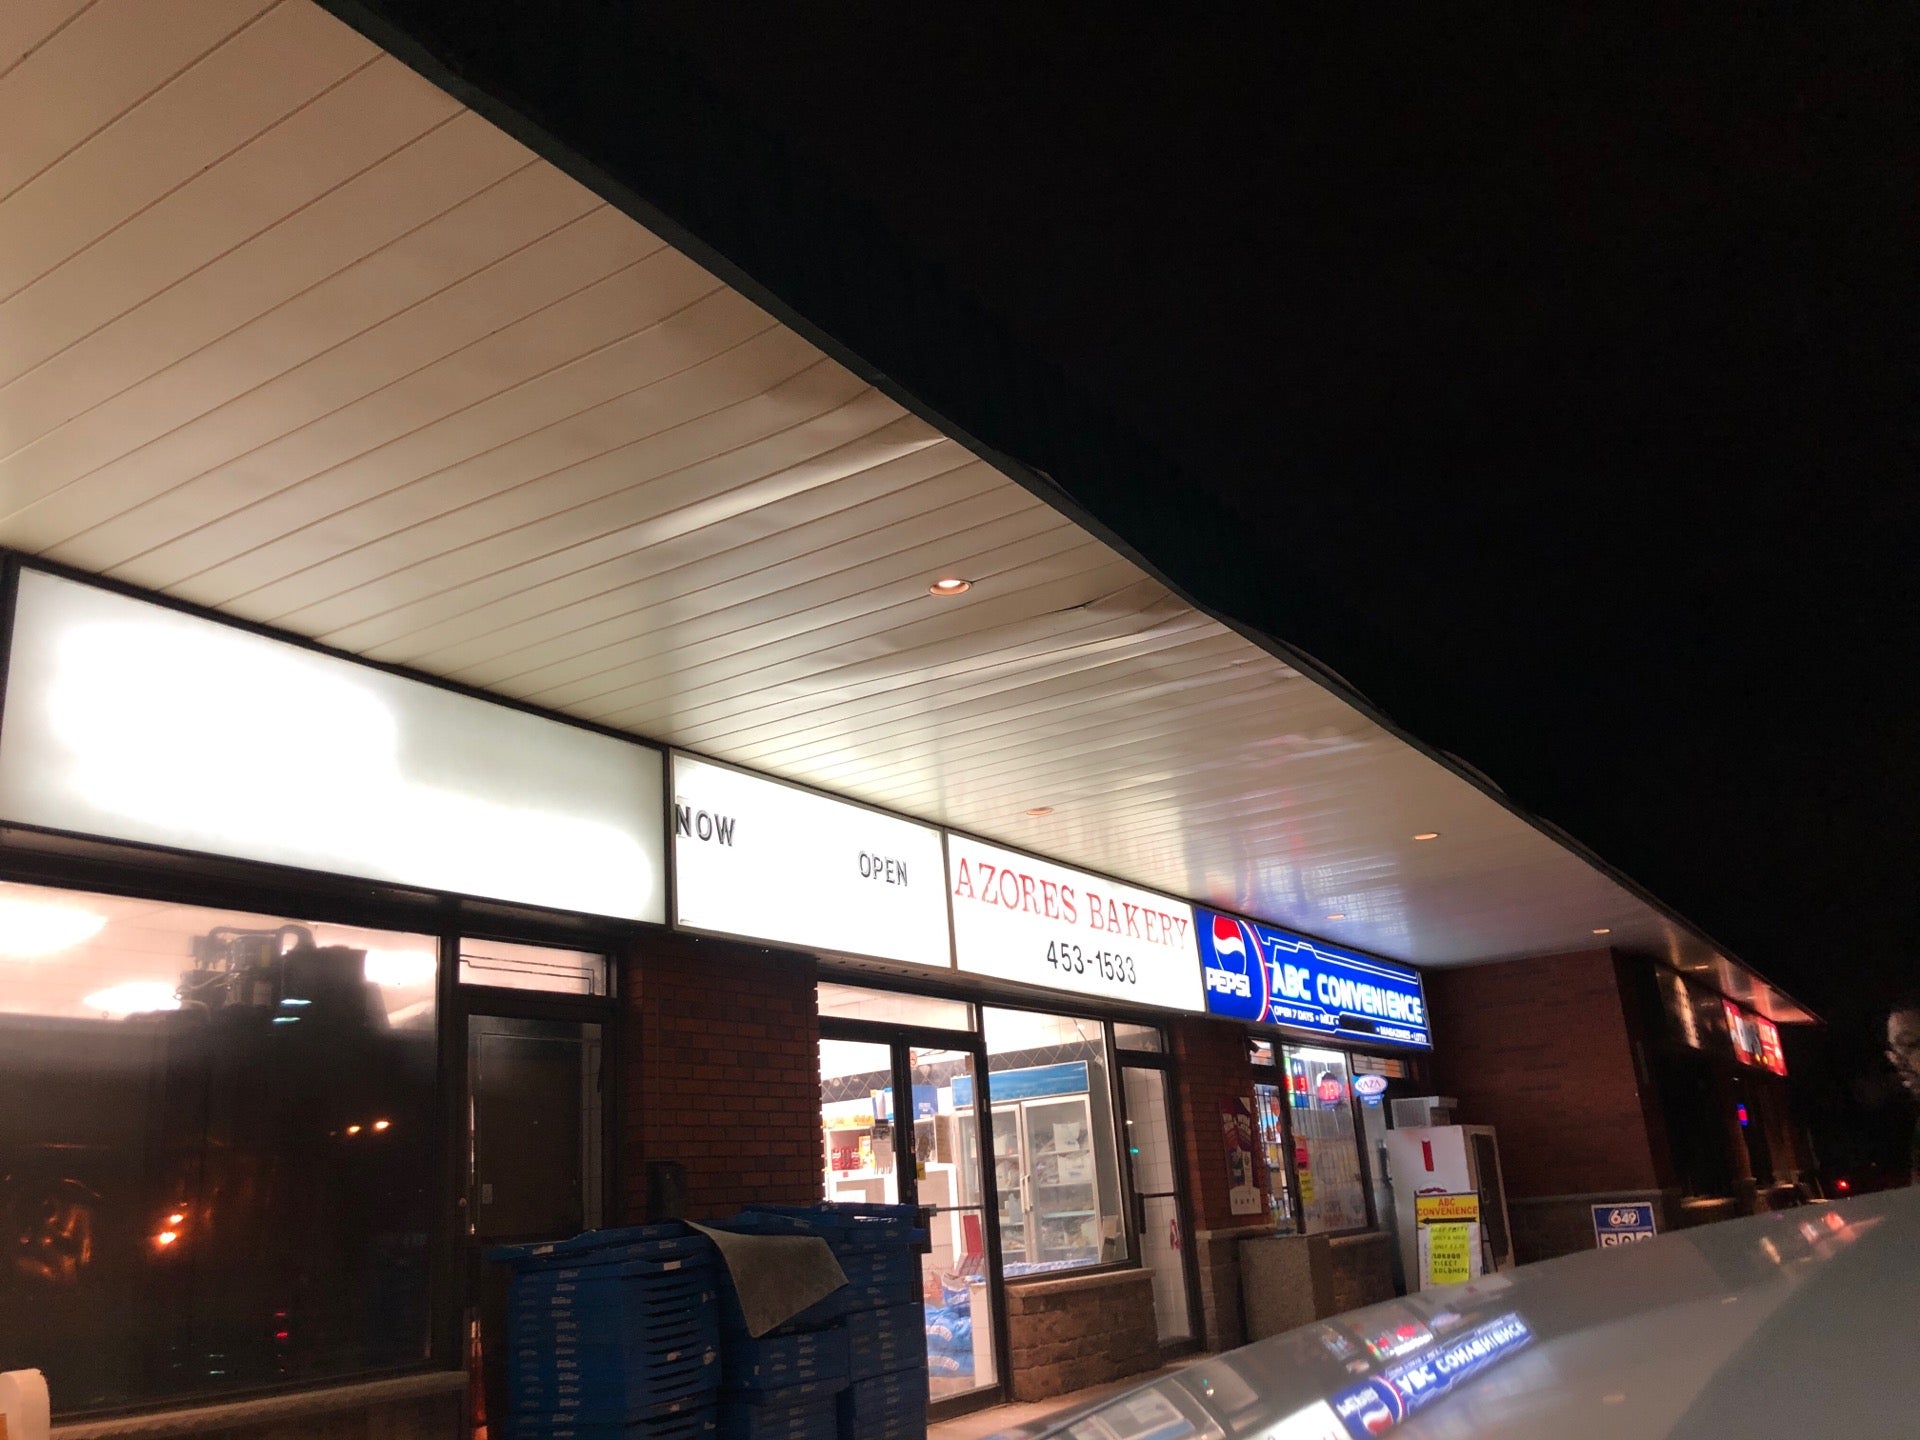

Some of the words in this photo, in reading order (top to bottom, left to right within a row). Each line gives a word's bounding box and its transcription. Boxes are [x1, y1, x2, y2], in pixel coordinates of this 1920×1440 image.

[675, 804, 736, 847] NOW
[859, 851, 908, 887] OPEN
[954, 857, 1077, 925] AZORES
[1086, 892, 1188, 949] BAKERY
[1047, 940, 1137, 985] 453-1533
[1205, 967, 1251, 998] PEPSI
[1272, 961, 1311, 1001] ABC
[1316, 973, 1423, 1024] CONVENIENCE
[1274, 1005, 1292, 1018] OPEN
[1298, 1010, 1315, 1022] DAYS
[1418, 1207, 1478, 1216] CONVENIENCE
[1438, 1198, 1455, 1206] ABC
